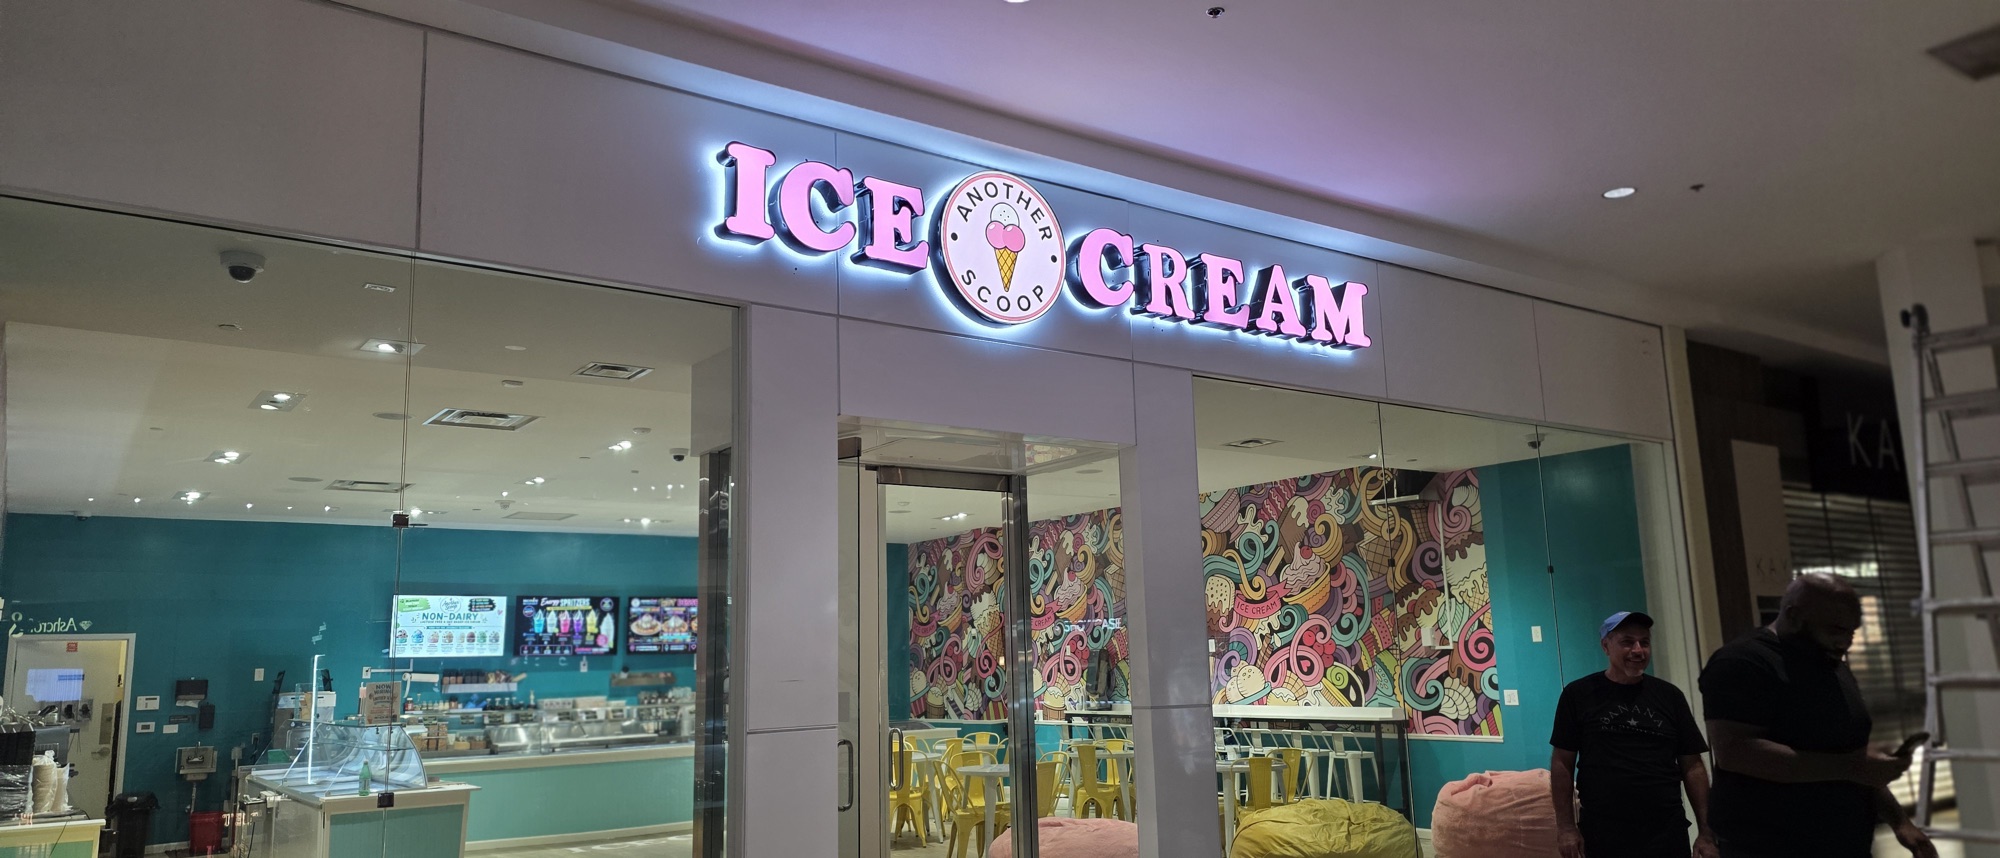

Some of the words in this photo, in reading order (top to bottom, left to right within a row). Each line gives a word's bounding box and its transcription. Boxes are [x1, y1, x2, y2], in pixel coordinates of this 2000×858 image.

[957, 181, 1053, 241] ANOTHER
[725, 140, 930, 271] ICE
[1078, 228, 1372, 347] CREAM
[961, 269, 1044, 312] SCOOP
[422, 612, 478, 620] NON-DAIRY
[1236, 601, 1249, 614] ICE
[1251, 601, 1277, 615] CREAM
[1599, 703, 1664, 728] BANANA
